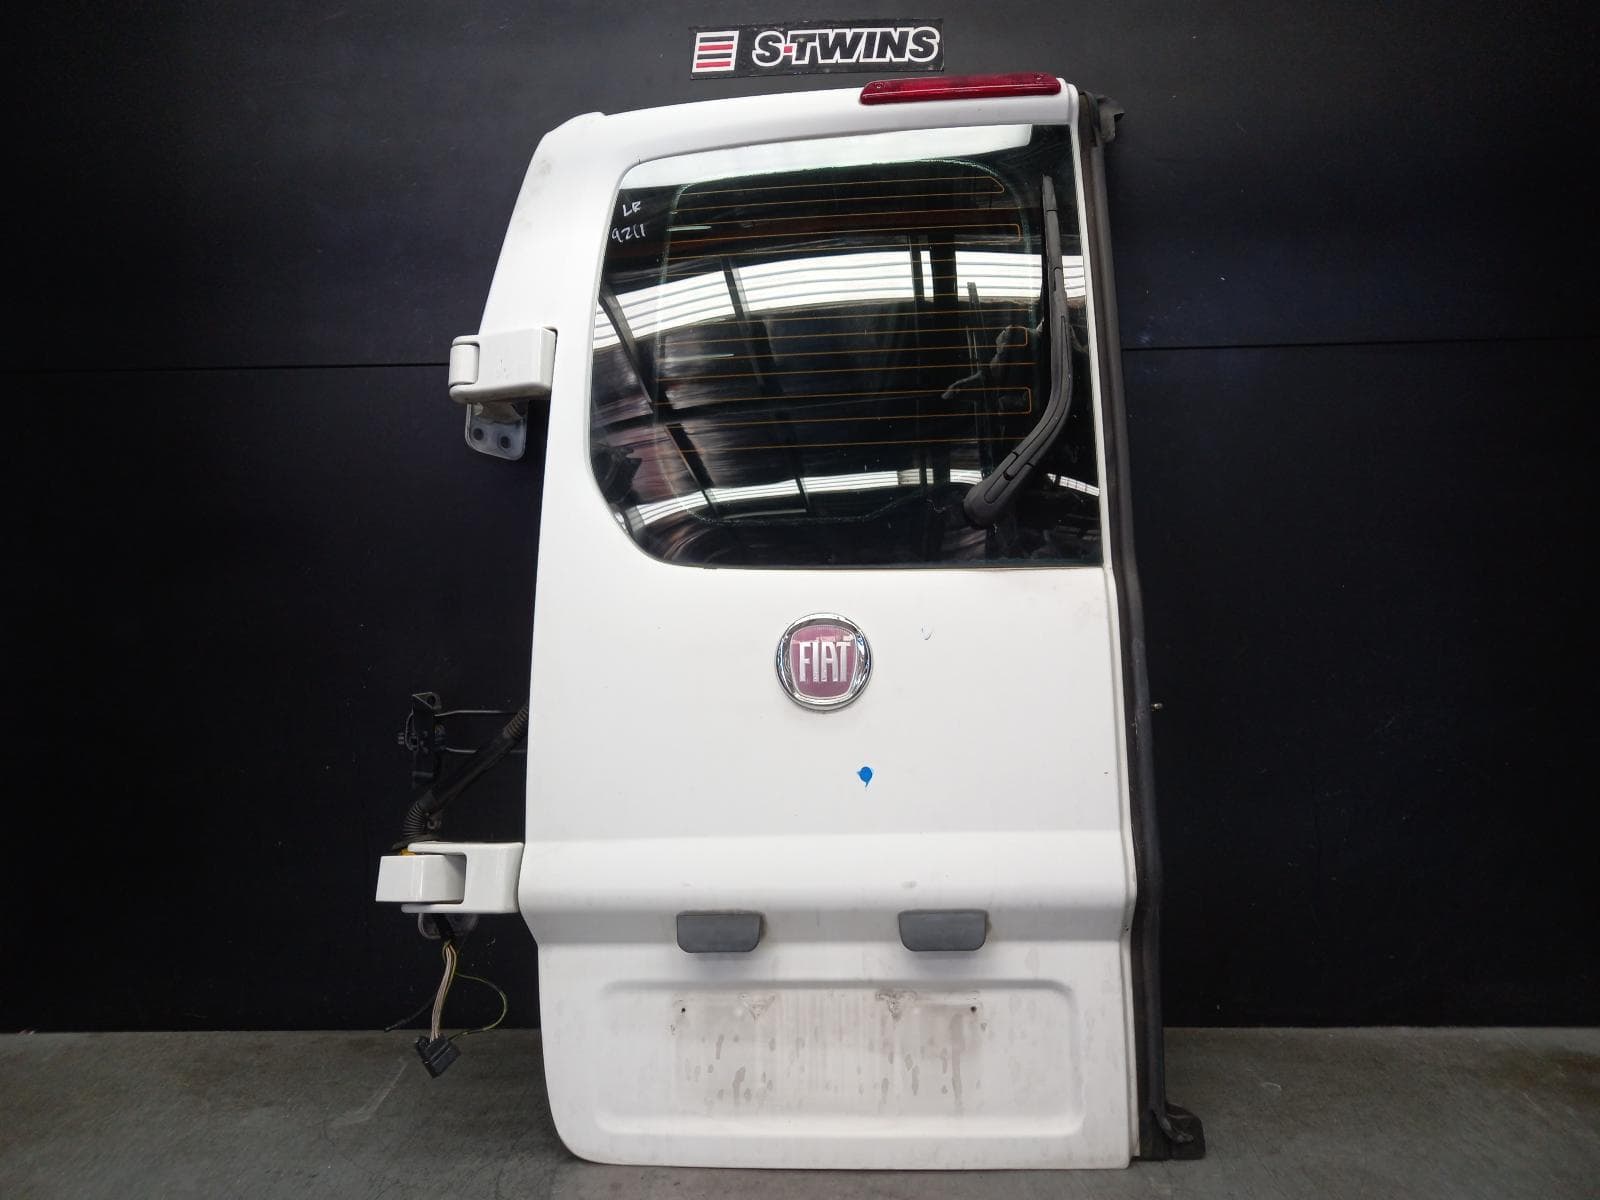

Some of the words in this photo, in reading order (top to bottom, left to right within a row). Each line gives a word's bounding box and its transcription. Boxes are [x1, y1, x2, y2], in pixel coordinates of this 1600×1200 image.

[752, 26, 941, 67] S-TWINS
[611, 224, 646, 243] 9211
[799, 640, 851, 682] FIAT
